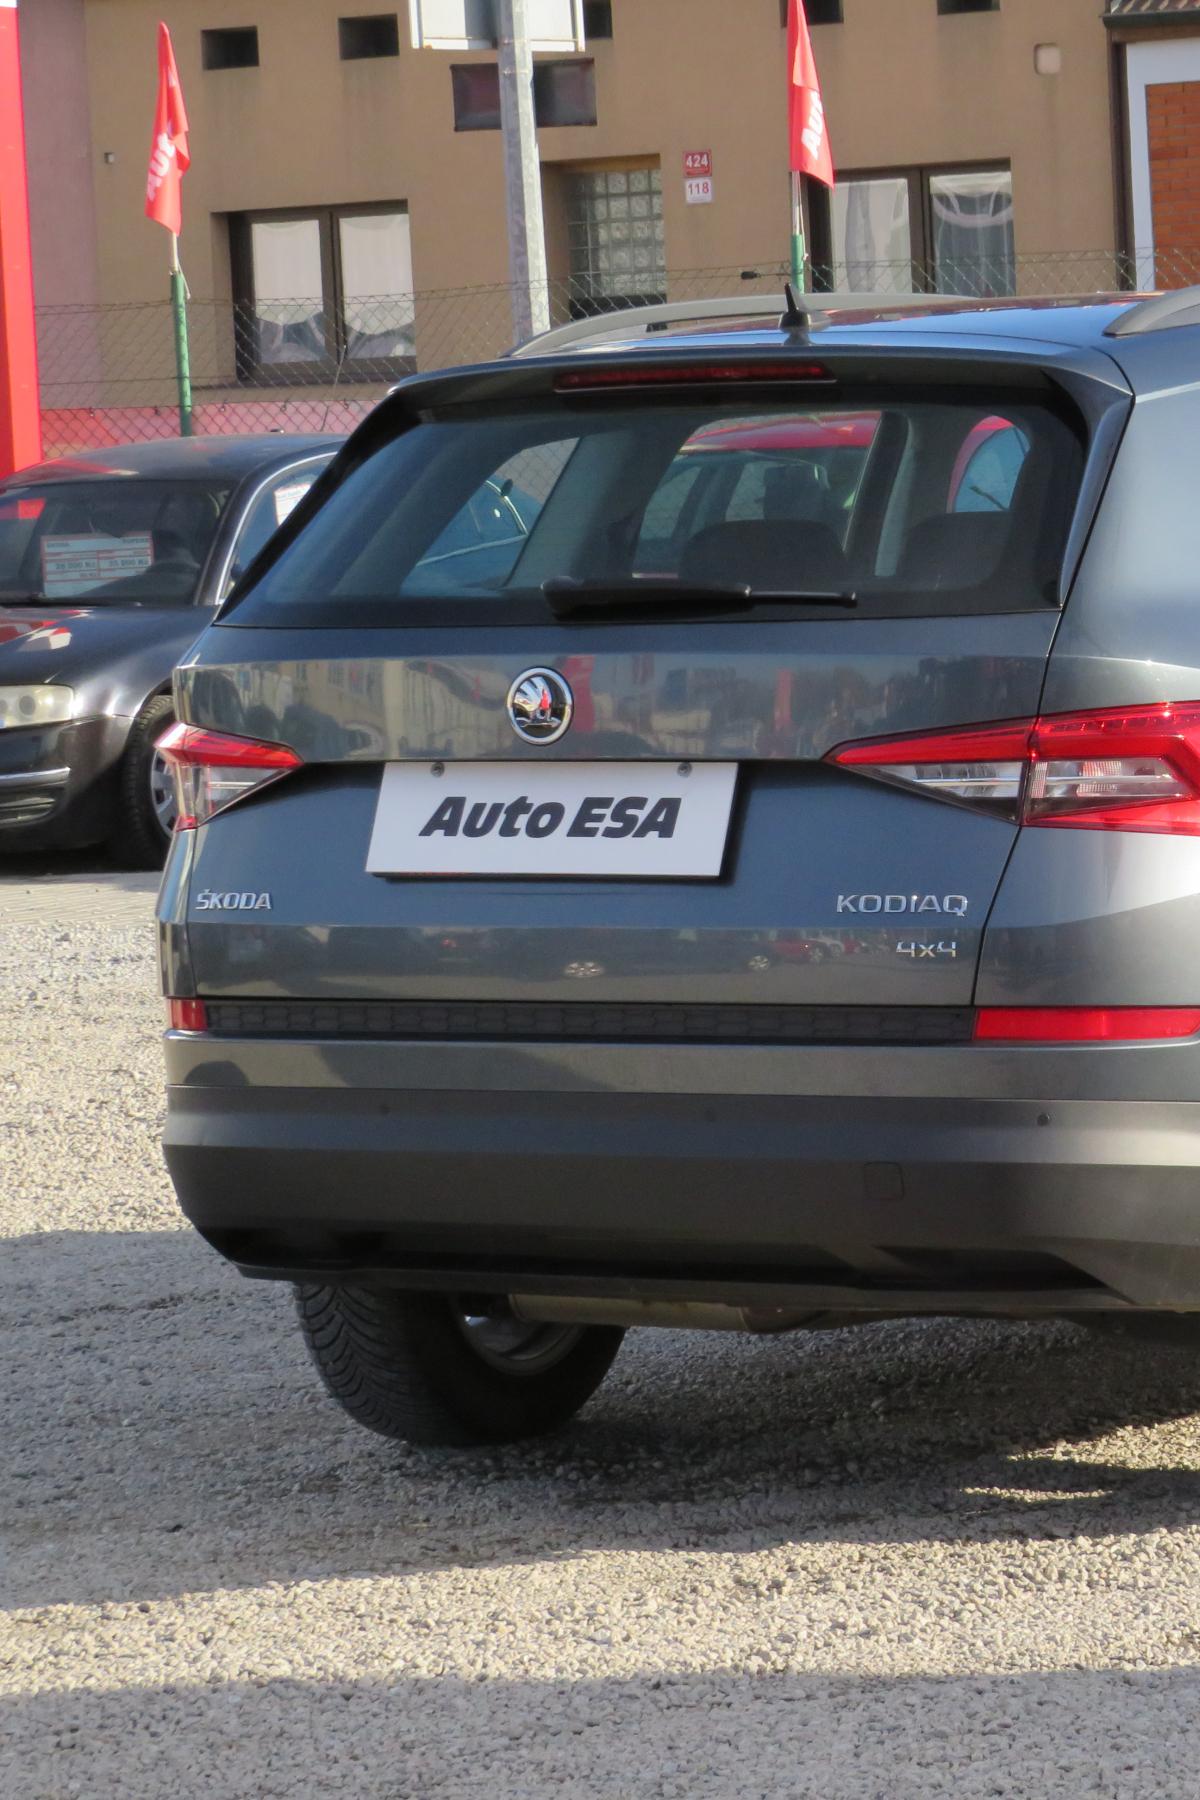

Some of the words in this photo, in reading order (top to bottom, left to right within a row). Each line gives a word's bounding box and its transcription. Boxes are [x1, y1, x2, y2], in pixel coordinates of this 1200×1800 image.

[686, 153, 709, 168] 424
[687, 182, 709, 195] 118
[418, 795, 566, 839] Auto
[566, 796, 682, 839] ESA
[195, 888, 273, 910] ŠKODA
[836, 894, 969, 917] KODIAQ
[895, 941, 957, 958] 4x4
